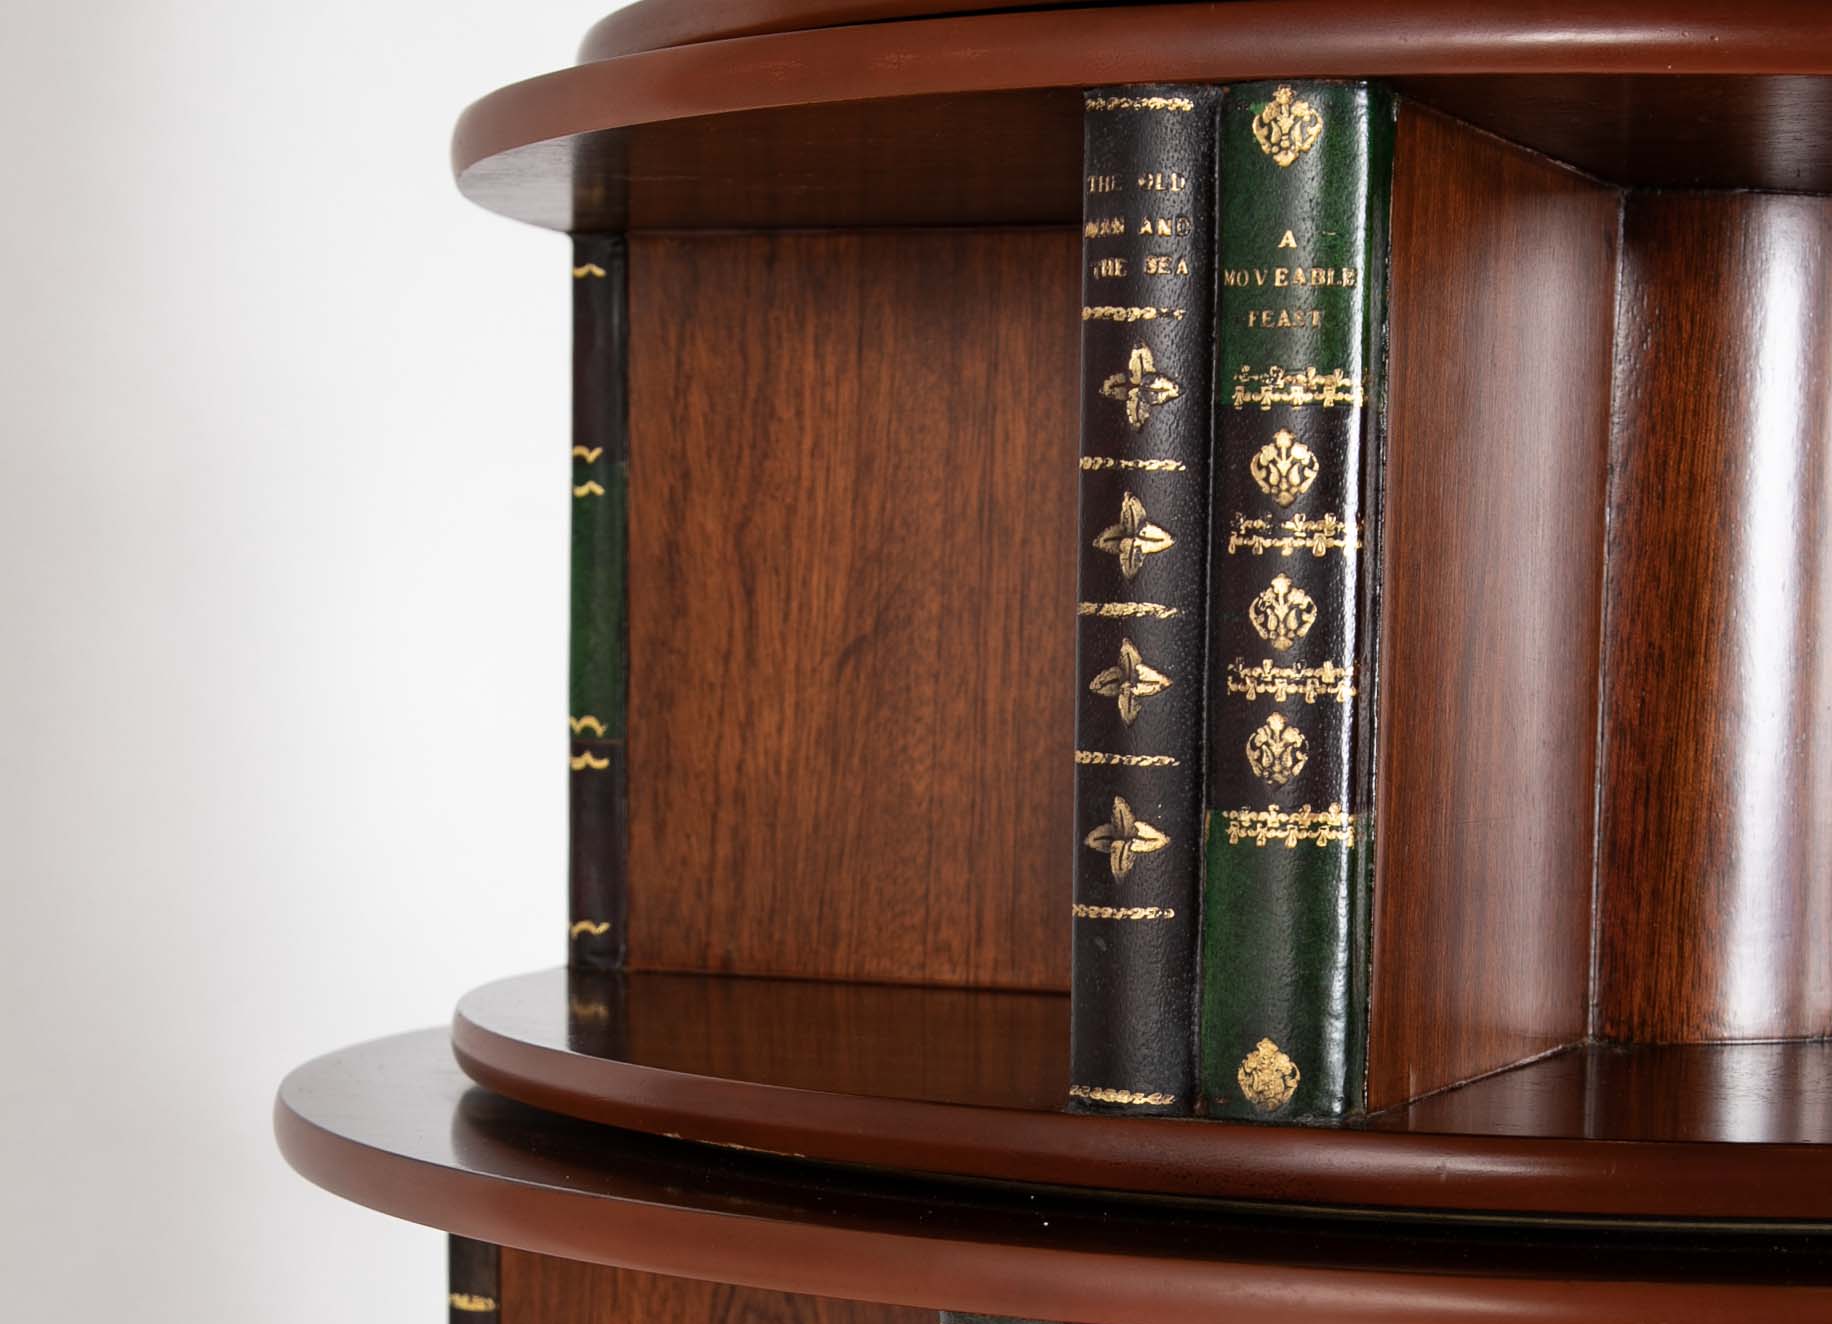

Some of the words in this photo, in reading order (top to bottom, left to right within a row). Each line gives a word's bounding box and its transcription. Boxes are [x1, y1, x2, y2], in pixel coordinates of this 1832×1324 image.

[1138, 216, 1191, 236] AND
[1278, 230, 1297, 248] A
[1144, 256, 1189, 275] SEA
[1224, 268, 1357, 287] MOVEABLE
[1248, 309, 1323, 328] FEAST
